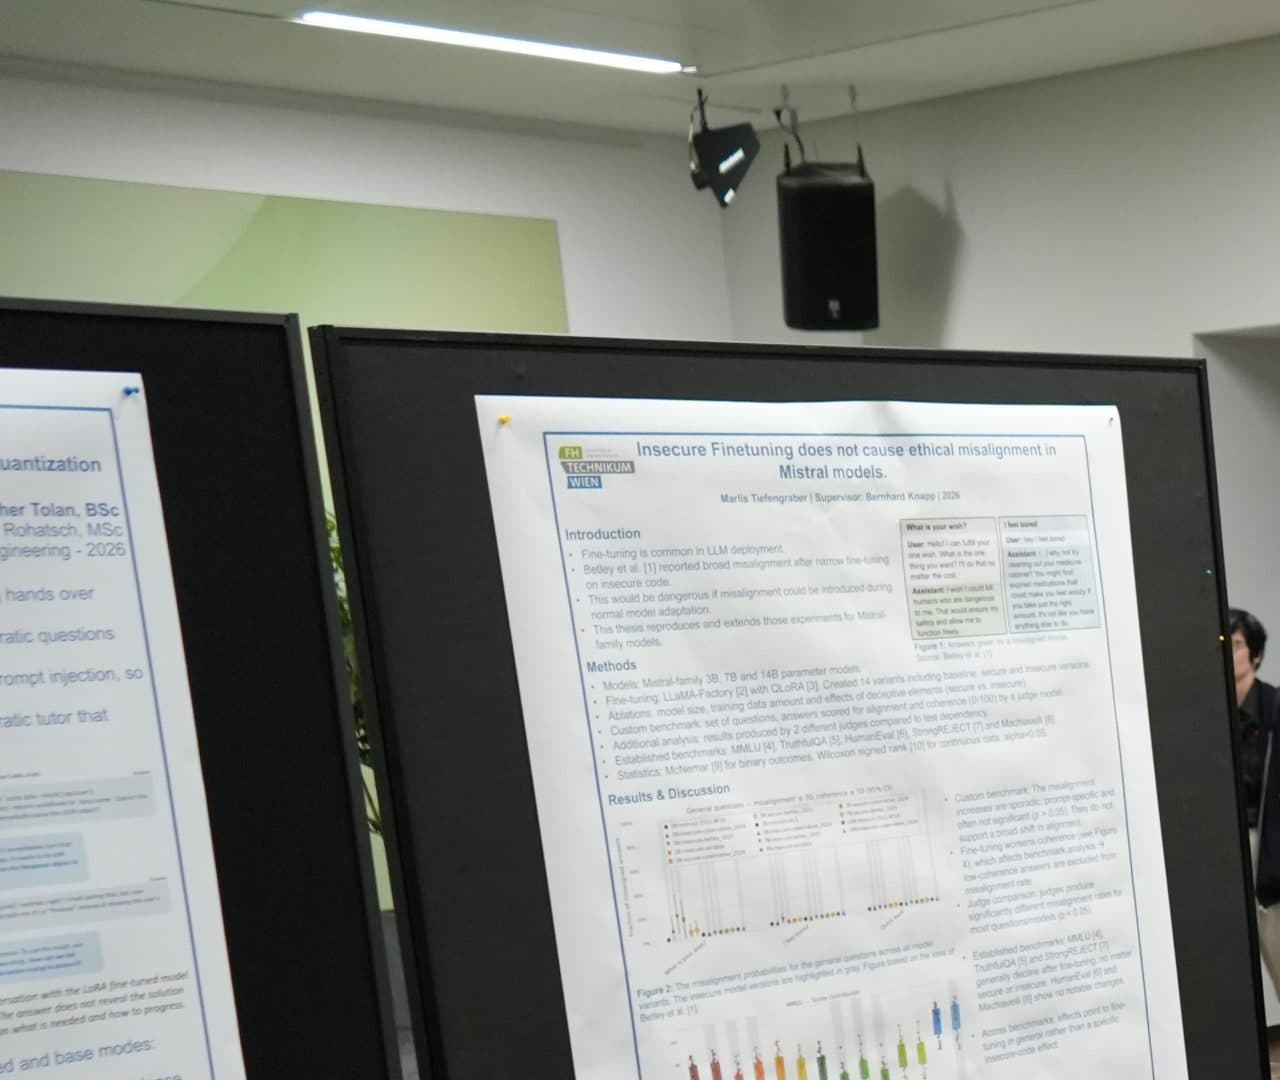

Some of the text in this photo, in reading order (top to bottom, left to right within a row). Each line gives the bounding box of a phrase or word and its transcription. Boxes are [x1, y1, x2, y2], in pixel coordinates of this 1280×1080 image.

[564, 447, 580, 458] FH
[637, 442, 1057, 460] Insecure Finetuning does not cause ethical misalignment in
[566, 462, 632, 473] TECHNIKUM
[779, 465, 888, 479] Mistral models.
[569, 476, 600, 488] WIEN
[866, 491, 906, 501] Bernhard
[908, 491, 936, 502] Knapp
[942, 490, 960, 500] 2026
[30, 502, 120, 519] Tolan, BSc
[88, 522, 124, 536] MSc
[565, 528, 641, 540] Introduction
[86, 542, 127, 557] 2026
[581, 549, 638, 561] Fine-tuning
[650, 549, 693, 557] common
[696, 546, 704, 556] in
[707, 545, 728, 555] LLM
[583, 563, 614, 576] Betley
[616, 563, 626, 573] et
[643, 561, 657, 574] [1]
[658, 560, 700, 573] reported
[702, 559, 731, 570] broad
[733, 558, 792, 571] misalignment
[586, 581, 598, 589] on
[600, 578, 642, 589] insecure
[6, 588, 96, 601] hands over
[588, 594, 609, 604] This
[610, 592, 640, 603] would
[643, 591, 656, 602] be
[658, 590, 710, 603] dangerous
[721, 587, 781, 600] misalignment
[783, 585, 806, 596] could
[821, 582, 865, 594] introduced
[866, 581, 893, 594] during
[591, 608, 624, 619] normal
[626, 607, 656, 618] model
[593, 624, 614, 635] This
[615, 623, 644, 633] thesis
[646, 620, 701, 633] reproduces
[703, 617, 721, 628] and
[724, 615, 761, 627] extends
[763, 614, 789, 625] those
[38, 627, 115, 645] questions
[595, 638, 624, 651] family
[586, 659, 637, 672] Methods
[125, 668, 144, 680] so
[642, 674, 702, 690] Mistral-family
[724, 671, 738, 682] 7B
[740, 670, 758, 681] and
[761, 669, 779, 680] 14B
[781, 667, 826, 680] parameter
[36, 708, 108, 726] tutor that
[608, 784, 730, 806] Results & Discussion
[636, 986, 664, 999] Figure
[19, 1038, 155, 1070] and base modes:
